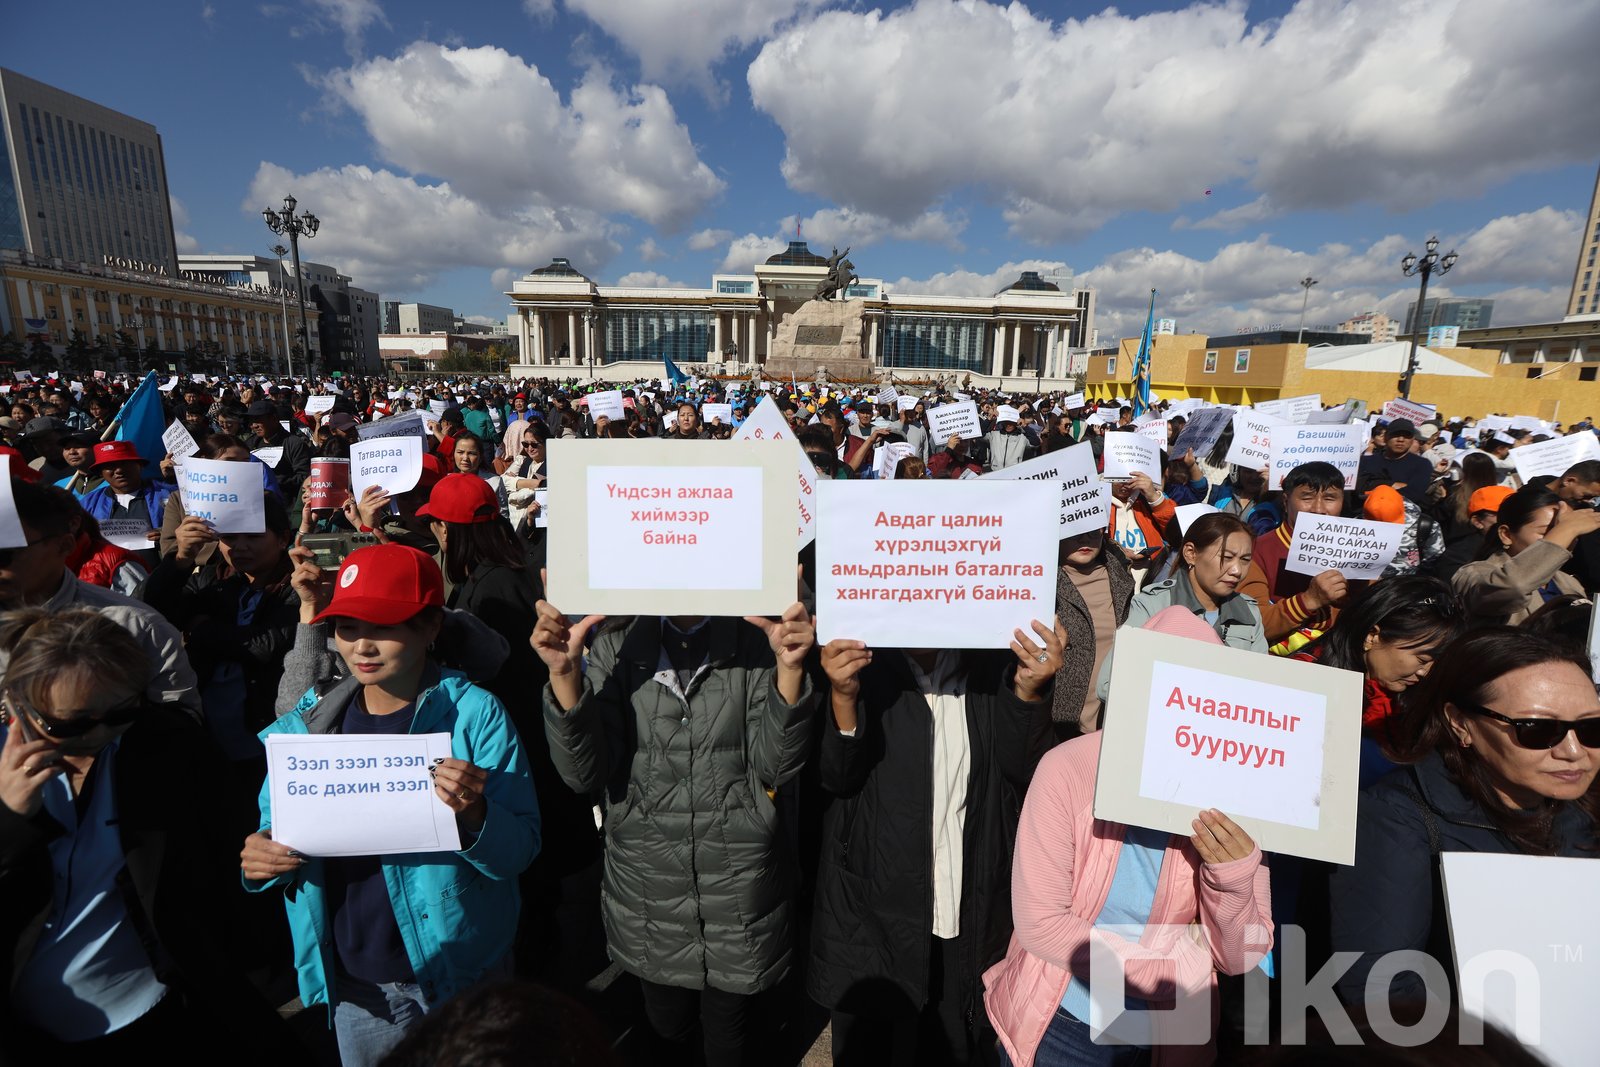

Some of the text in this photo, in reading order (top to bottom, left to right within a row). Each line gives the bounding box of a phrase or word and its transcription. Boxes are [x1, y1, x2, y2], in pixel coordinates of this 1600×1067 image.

[1247, 421, 1270, 434] ҮНДС
[1297, 430, 1346, 440] Багшийн
[358, 448, 403, 461] Татвараа
[1241, 447, 1270, 461] ТӨГРӨ
[1283, 444, 1355, 455] хөдөлмөрийг
[360, 465, 398, 477] багасга
[607, 484, 733, 500] Үндсэн ажлаа
[631, 508, 710, 525] хиймээр
[875, 512, 1003, 530] Авдаг цалин
[643, 530, 697, 545] байна
[1316, 522, 1376, 537] ХАМТДАА
[874, 536, 1002, 555] хүрэлцэхгүй
[1299, 531, 1388, 550] САЙН САЙХАН
[1300, 543, 1380, 560] ИРЭЭДҮЙГЭЭ
[831, 561, 1043, 579] амьдралын баталгаа
[836, 585, 1037, 603] хангагдахгүй байна.
[1165, 686, 1301, 732] Ачааллыг
[1175, 725, 1285, 768] бууруул
[287, 756, 425, 771] Зээл зээл зээл
[287, 780, 429, 797] бас дахин зээл
